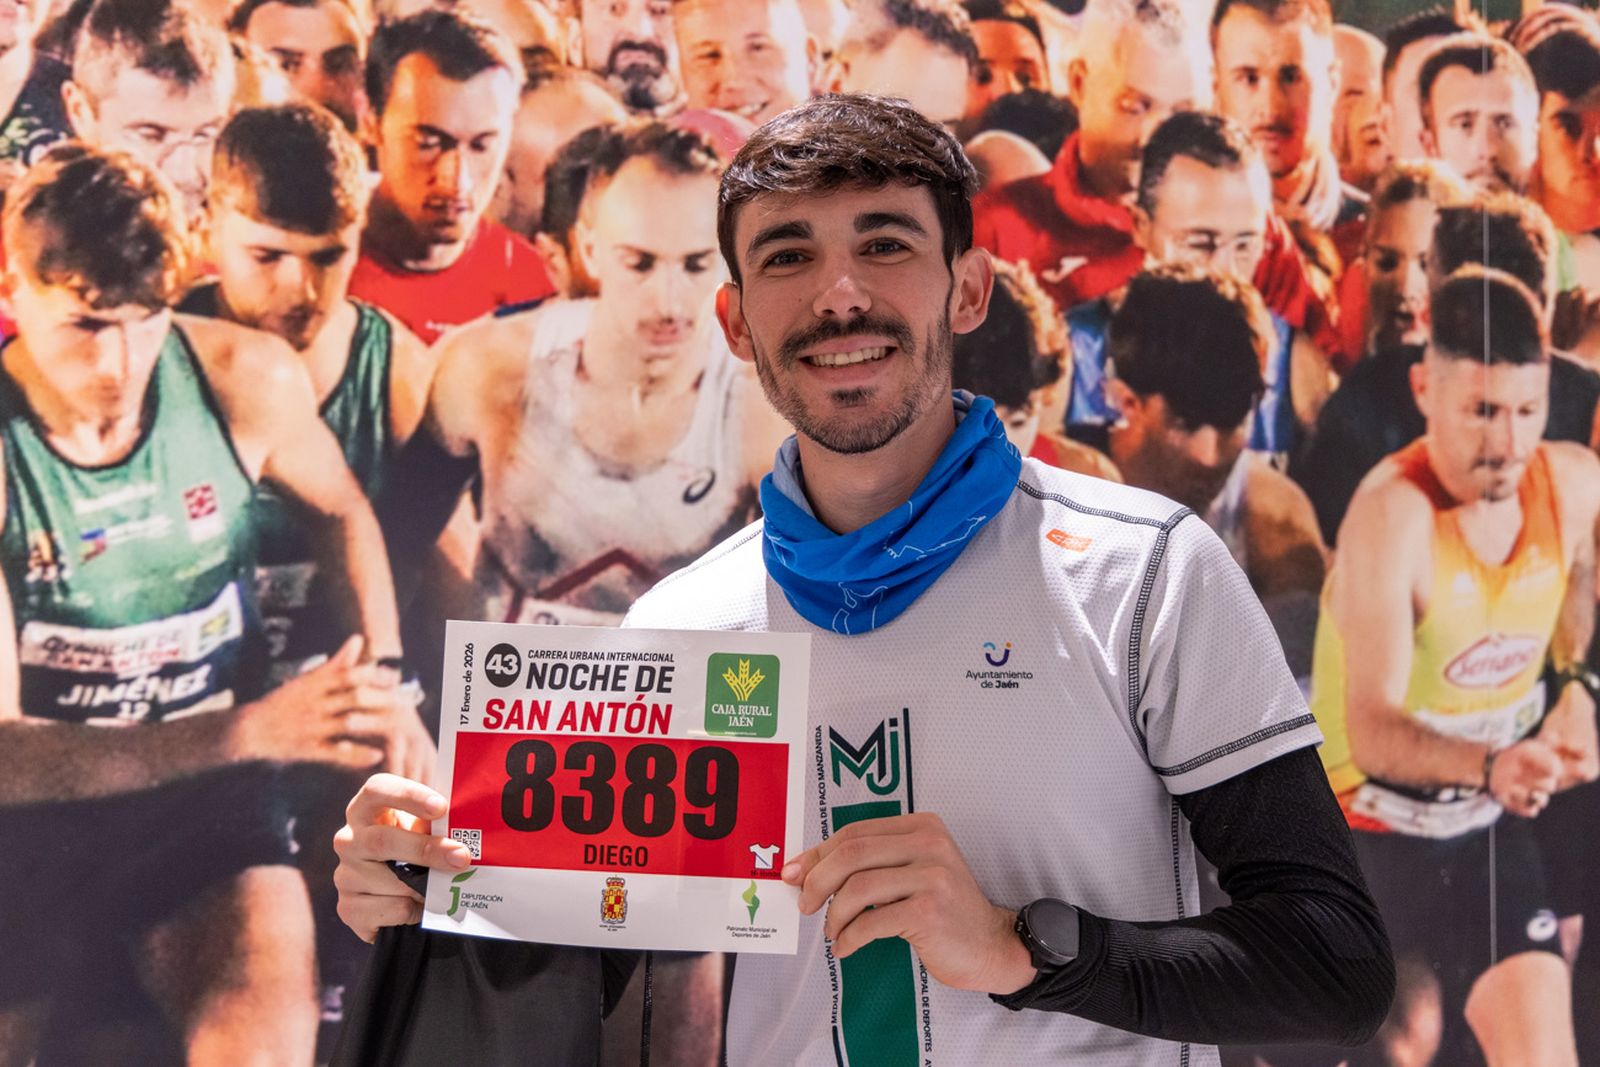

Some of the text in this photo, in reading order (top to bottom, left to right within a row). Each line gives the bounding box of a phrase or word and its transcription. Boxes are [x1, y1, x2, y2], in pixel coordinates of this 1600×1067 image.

[485, 653, 518, 674] 43
[528, 649, 675, 663] CARRERA URBANA INTERNACIONAL
[460, 642, 474, 725] 17 Enero de 2026
[525, 662, 675, 694] NOCHE DE
[965, 670, 1033, 681] Ayuntamiento
[980, 679, 1019, 689] de Jaén
[482, 694, 673, 735] SAN ANTÓN
[711, 703, 772, 717] CAJA RURAL
[728, 714, 754, 727] JAÉN
[500, 739, 740, 840] 8389
[815, 725, 829, 841] ORIA DE PACO MANZANEDA
[583, 843, 649, 868] DIEGO
[461, 892, 504, 902] DIPUTACIÓN
[824, 945, 839, 992] MARATÓN
[922, 996, 929, 1008] DE
[923, 1009, 932, 1053] DEPORTES
